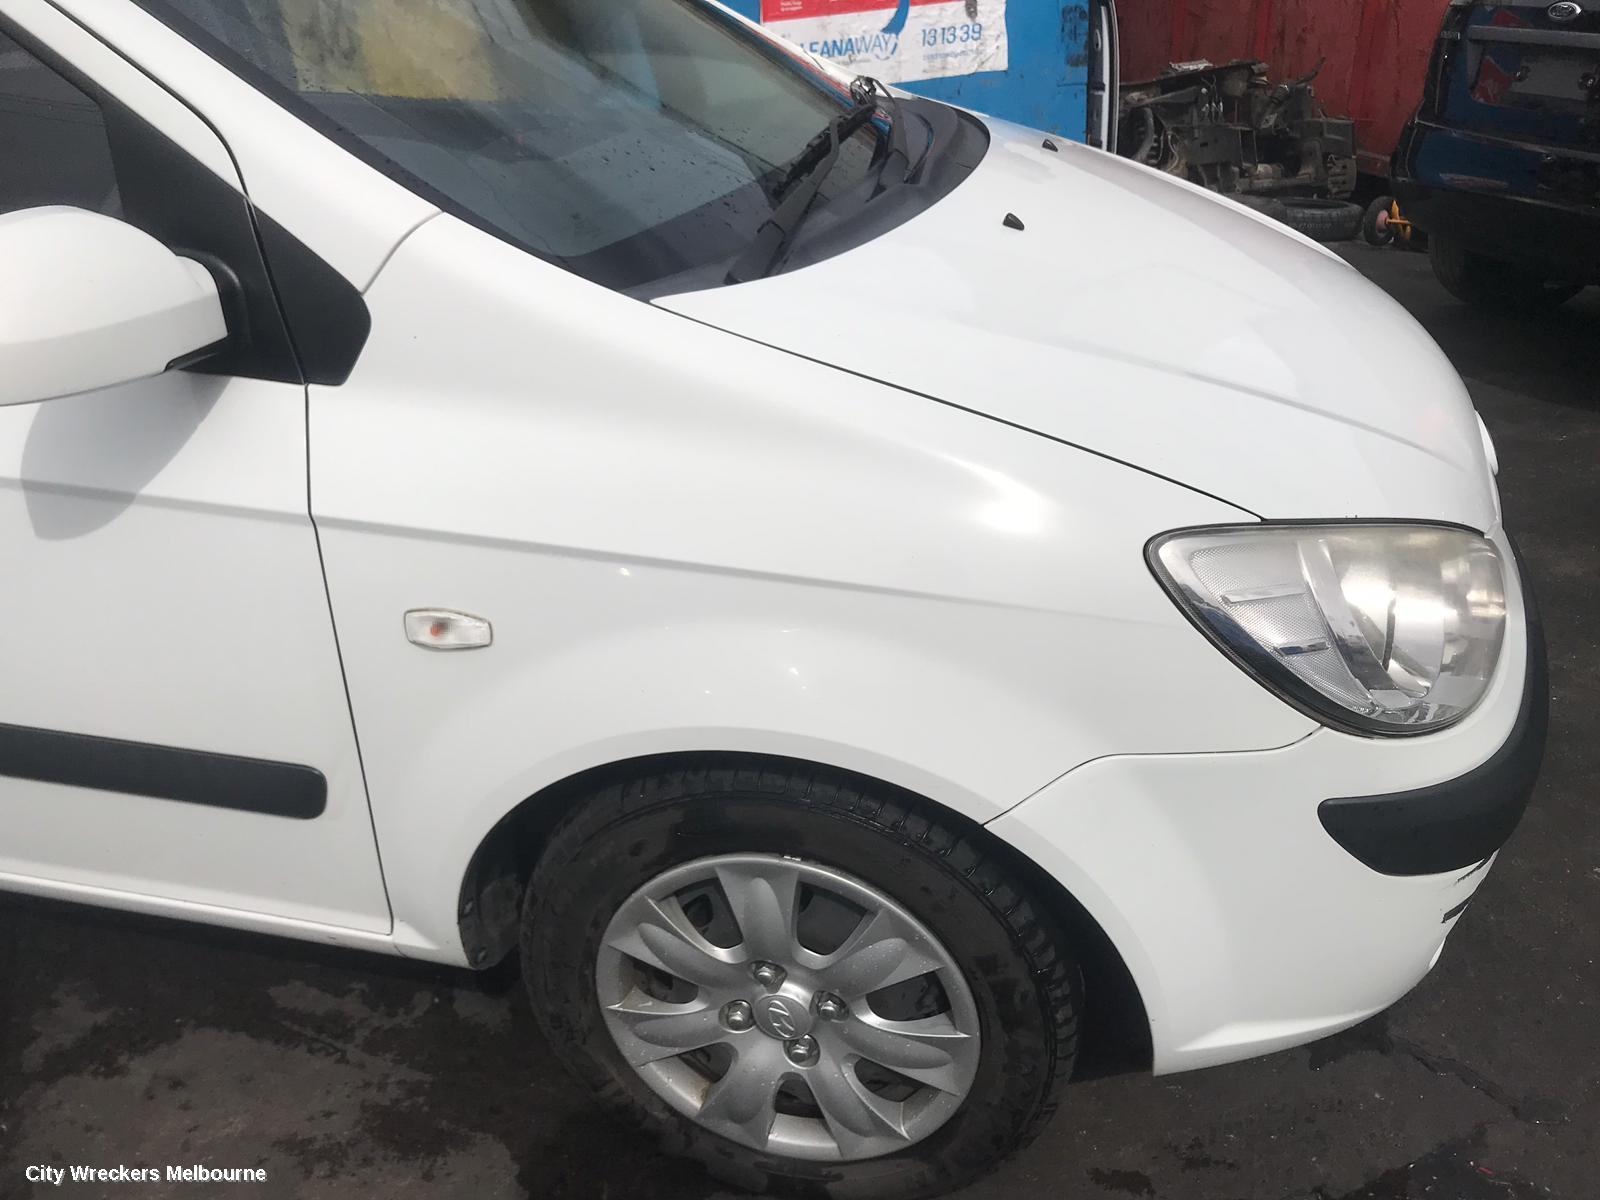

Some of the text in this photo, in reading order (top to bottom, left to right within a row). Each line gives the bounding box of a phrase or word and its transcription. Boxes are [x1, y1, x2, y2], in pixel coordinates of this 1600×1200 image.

[922, 23, 982, 47] 13 13 39
